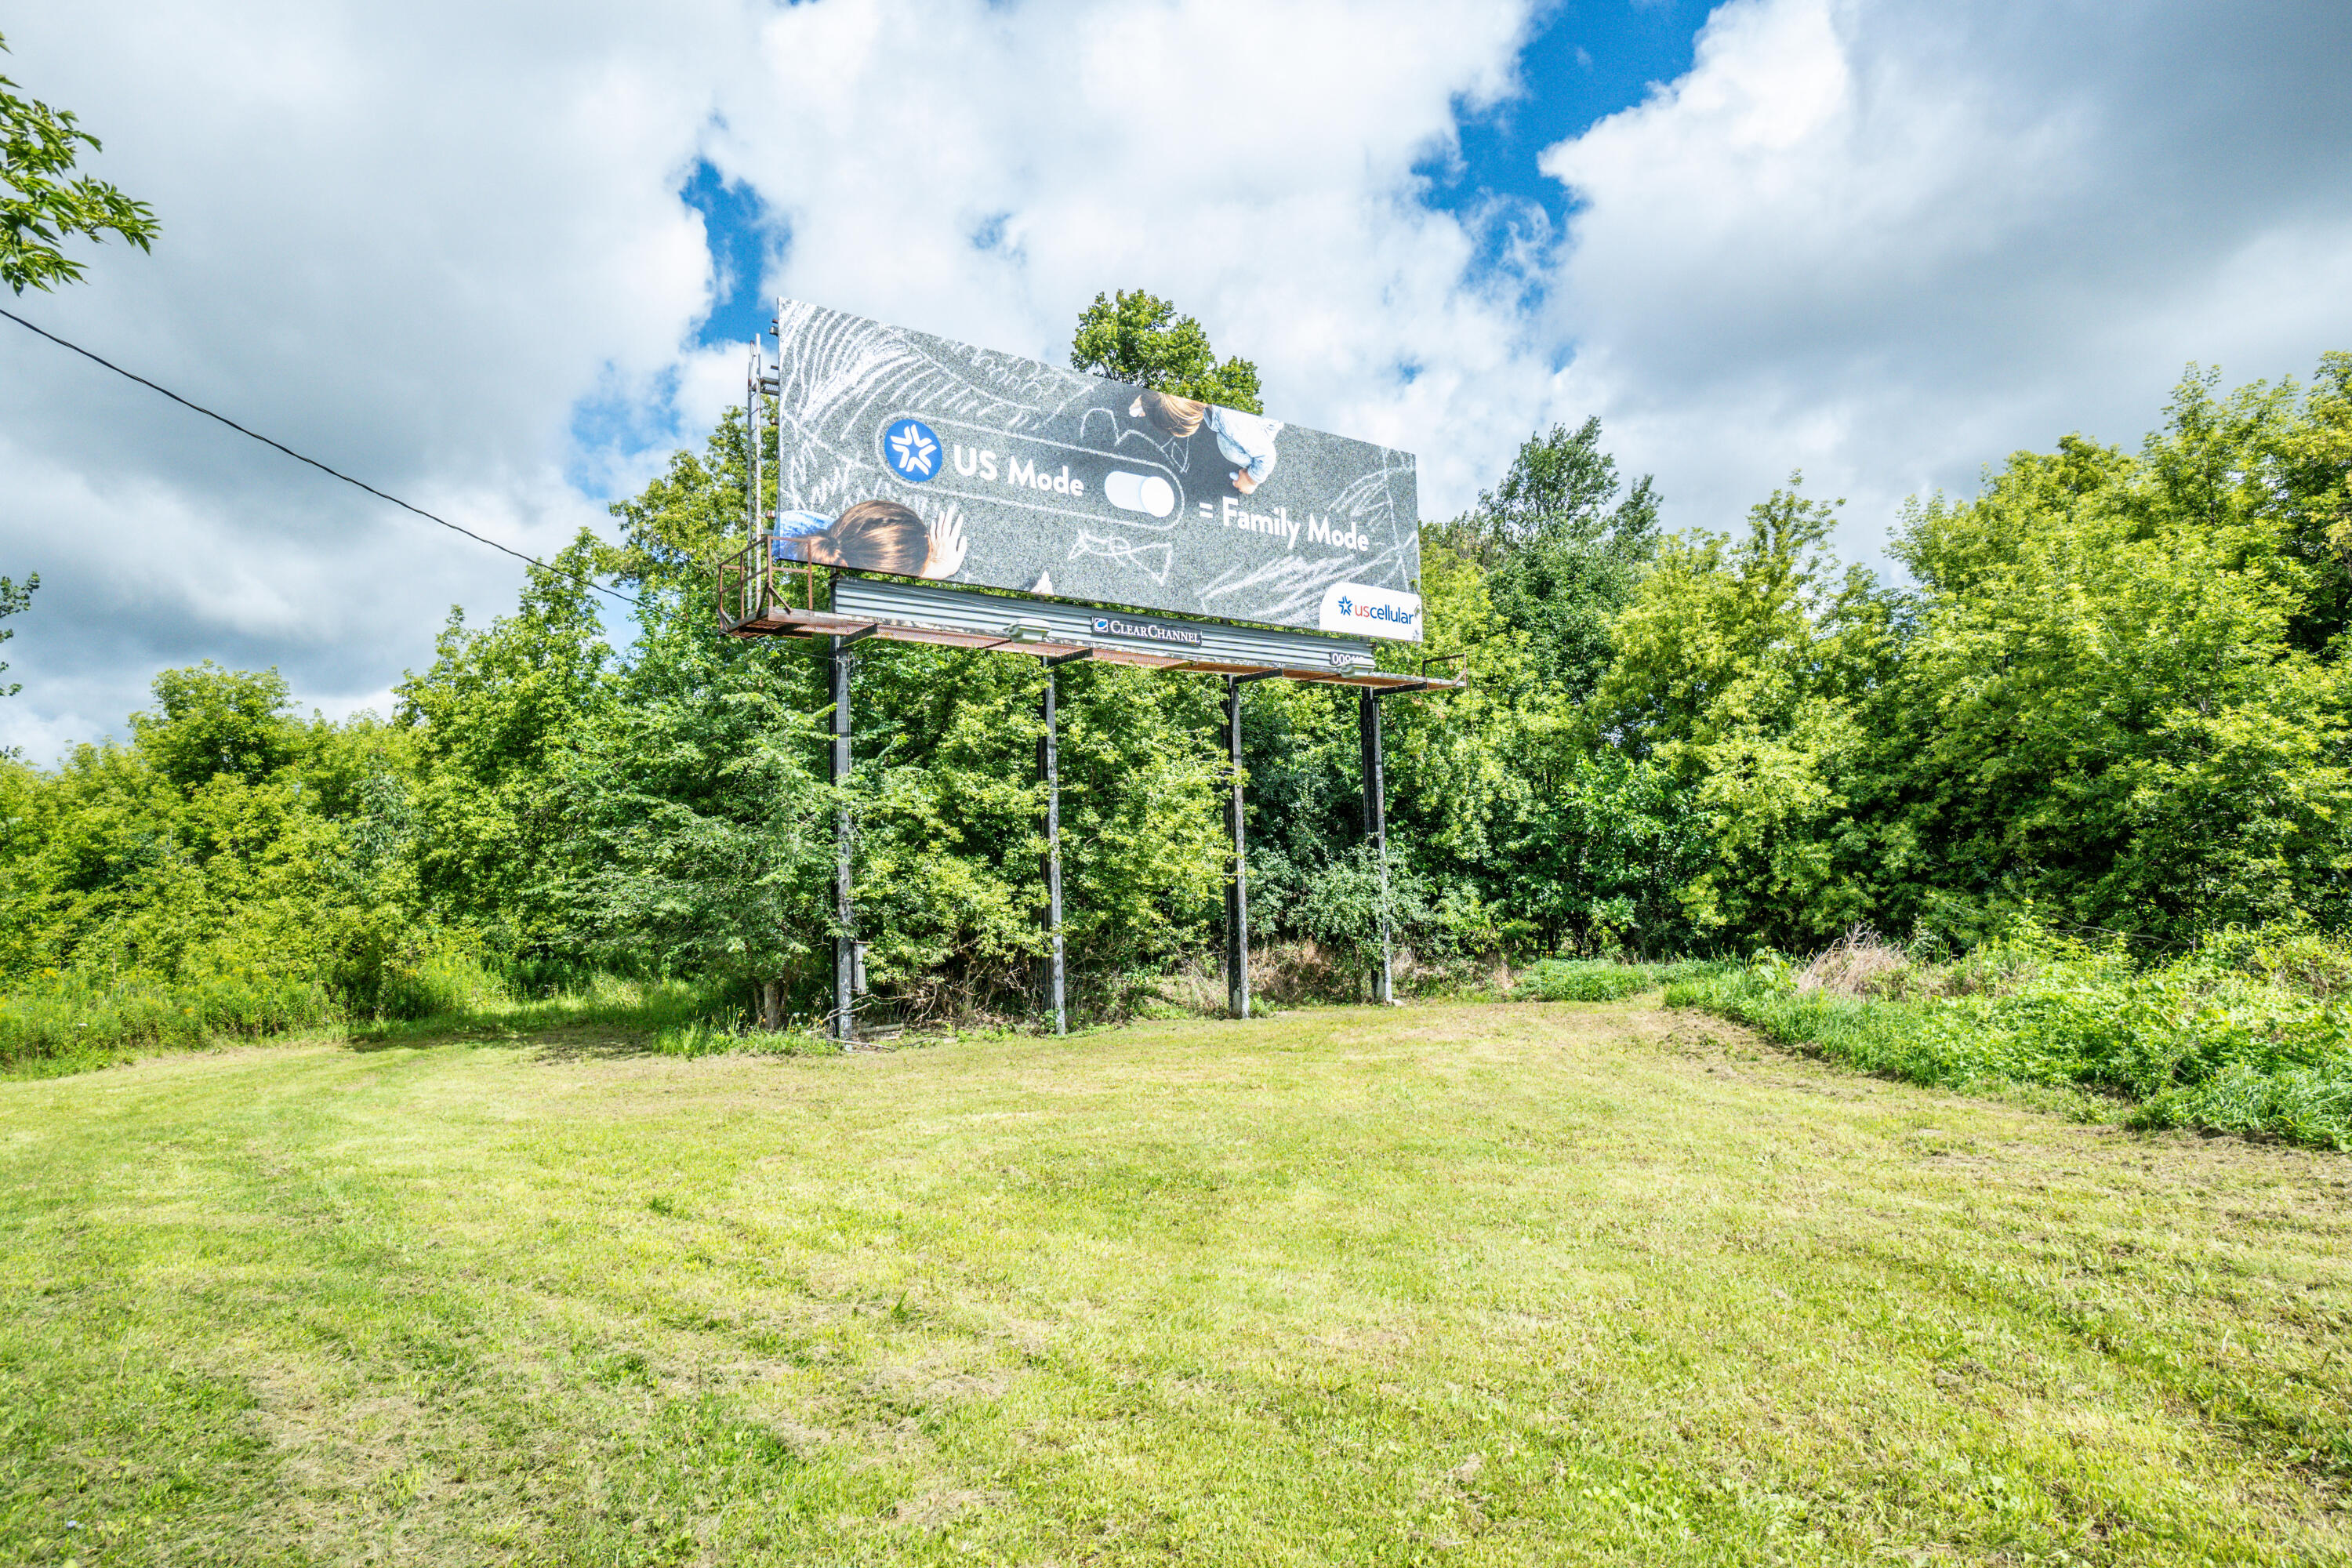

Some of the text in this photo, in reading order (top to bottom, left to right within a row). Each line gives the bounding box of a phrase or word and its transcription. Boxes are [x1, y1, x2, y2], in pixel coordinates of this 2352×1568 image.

[954, 444, 1084, 496] US Mode
[1222, 495, 1301, 550] Family
[1307, 513, 1370, 552] Mode
[1355, 604, 1414, 625] uscellular
